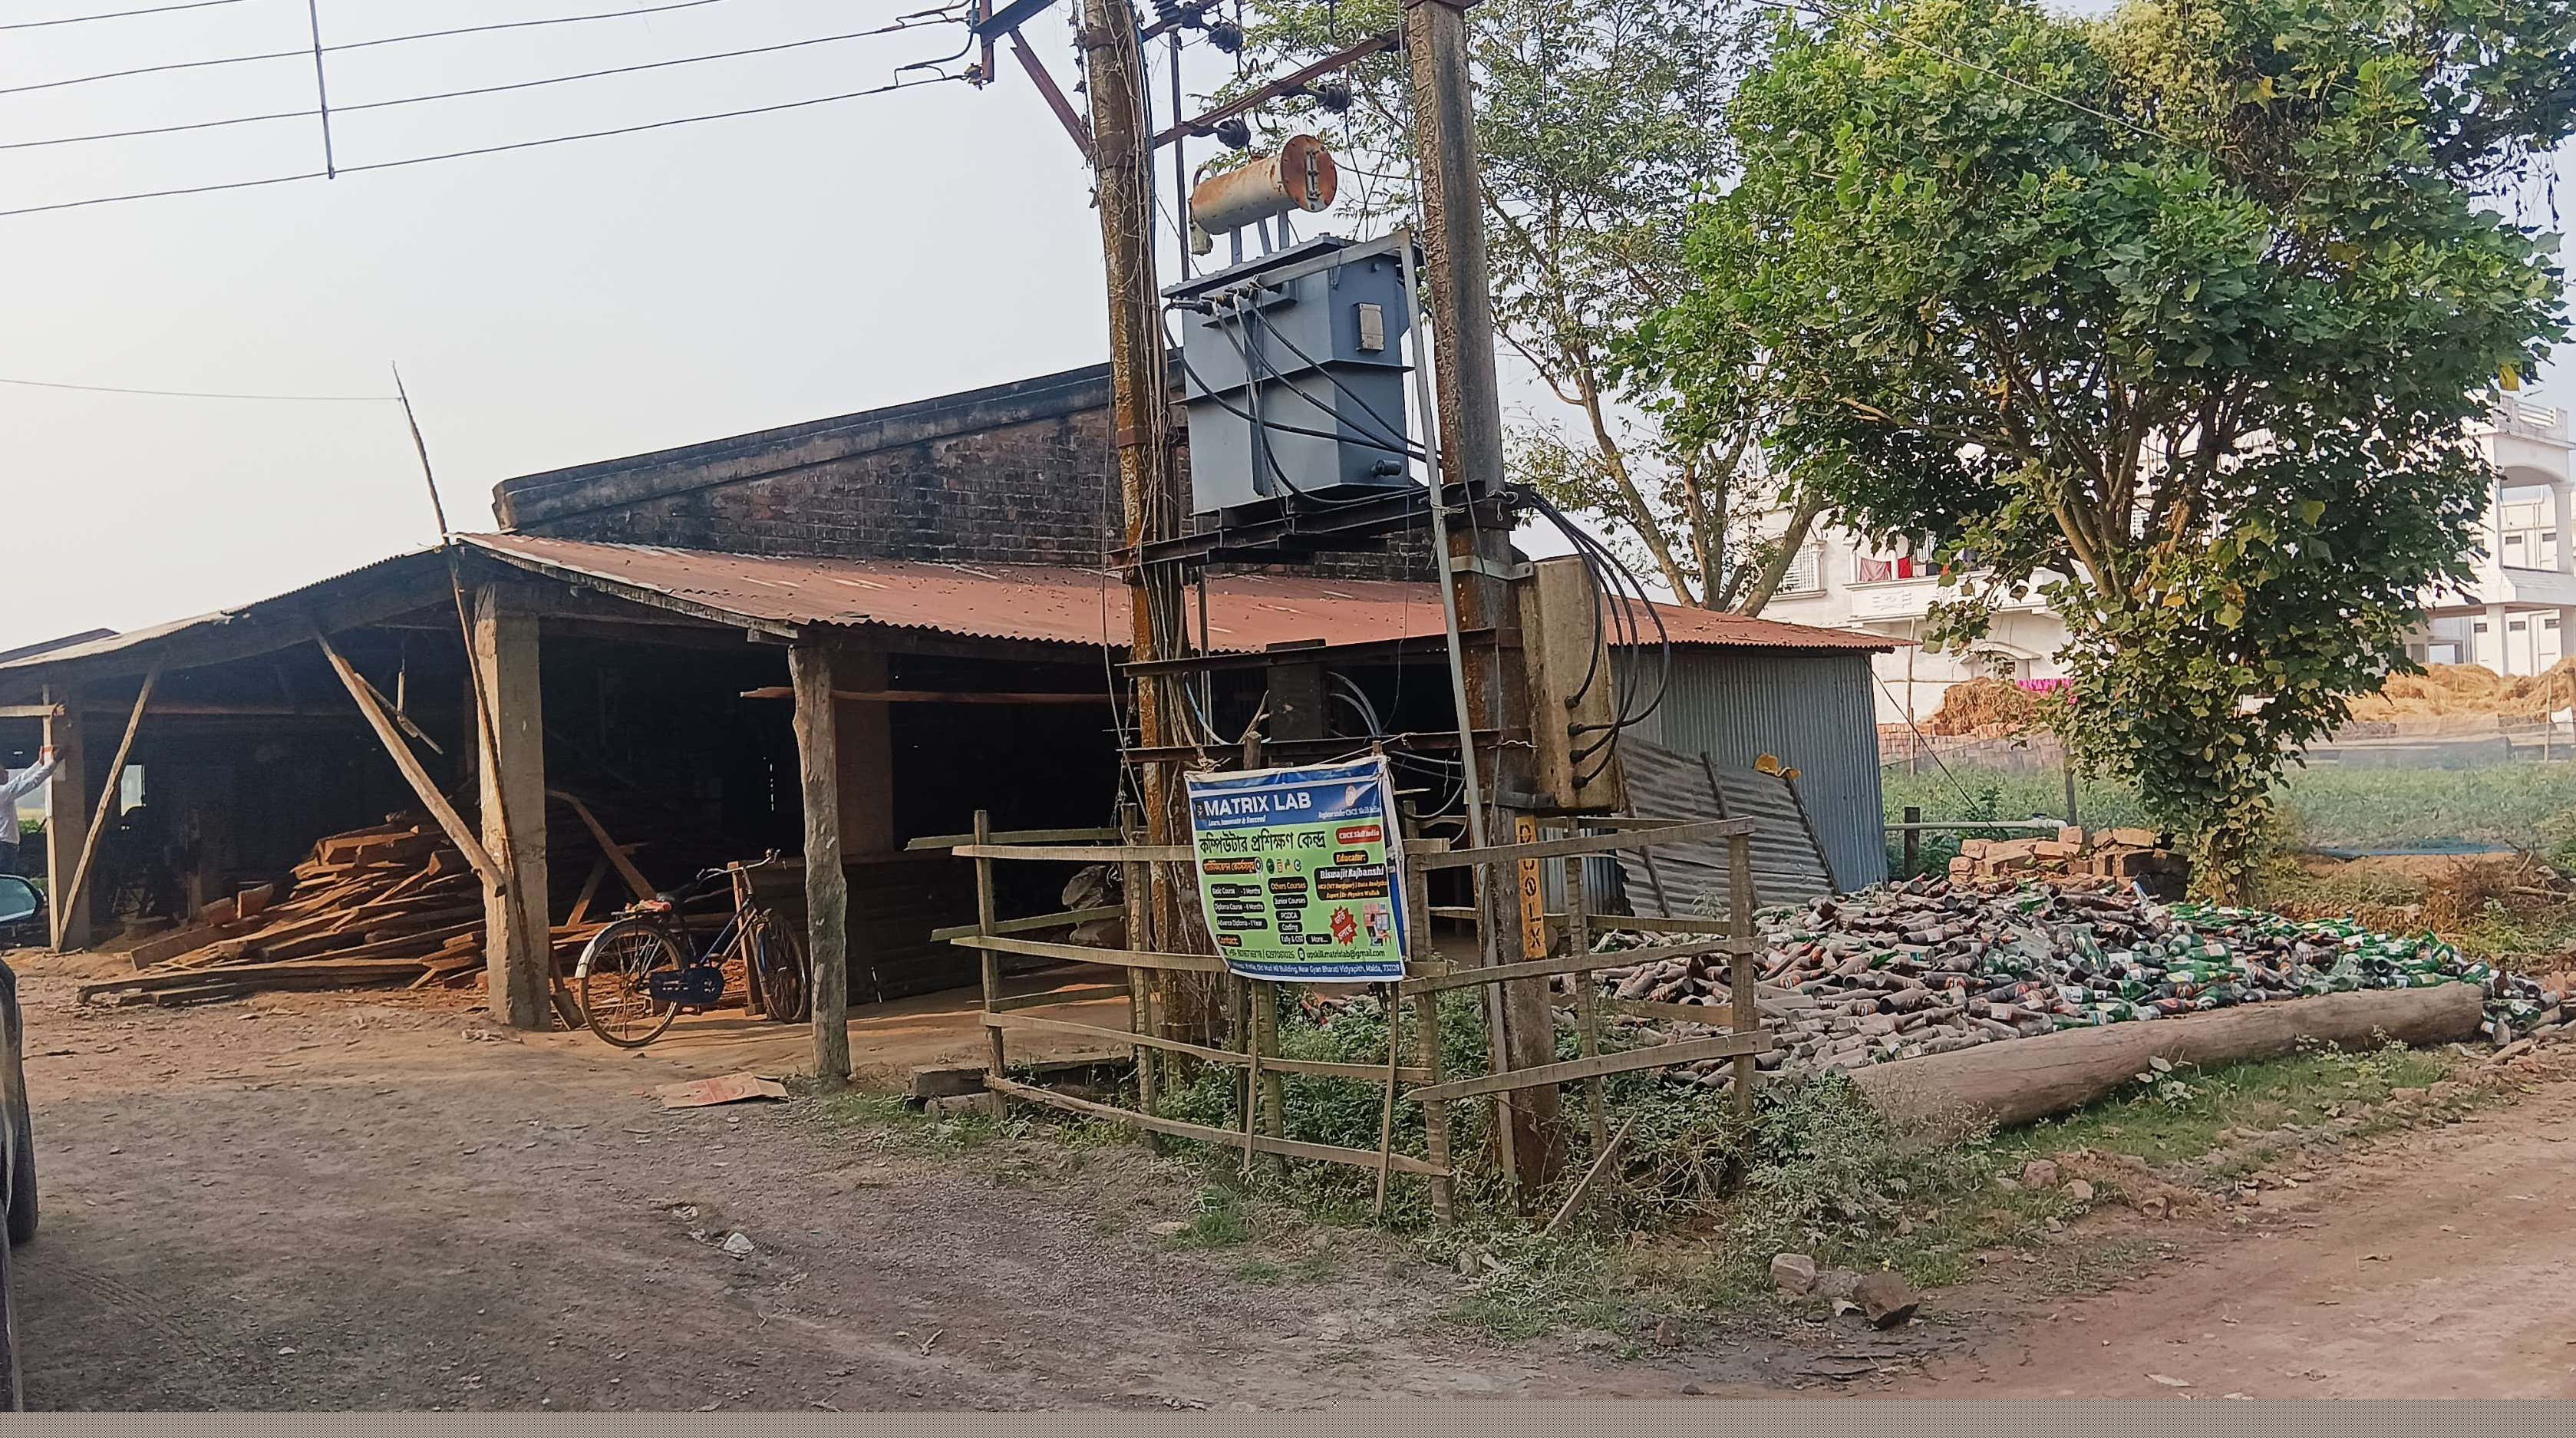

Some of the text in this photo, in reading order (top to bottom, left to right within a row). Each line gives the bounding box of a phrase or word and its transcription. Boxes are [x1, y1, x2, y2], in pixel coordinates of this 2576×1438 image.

[1204, 796, 1270, 816] MATRIX
[1273, 792, 1311, 810] LAB
[1199, 828, 1326, 853] কম্পিউটার প্রশিক্ষণ কেন্দ্র
[1320, 869, 1348, 879] Biswajit
[1281, 923, 1298, 932] Coding
